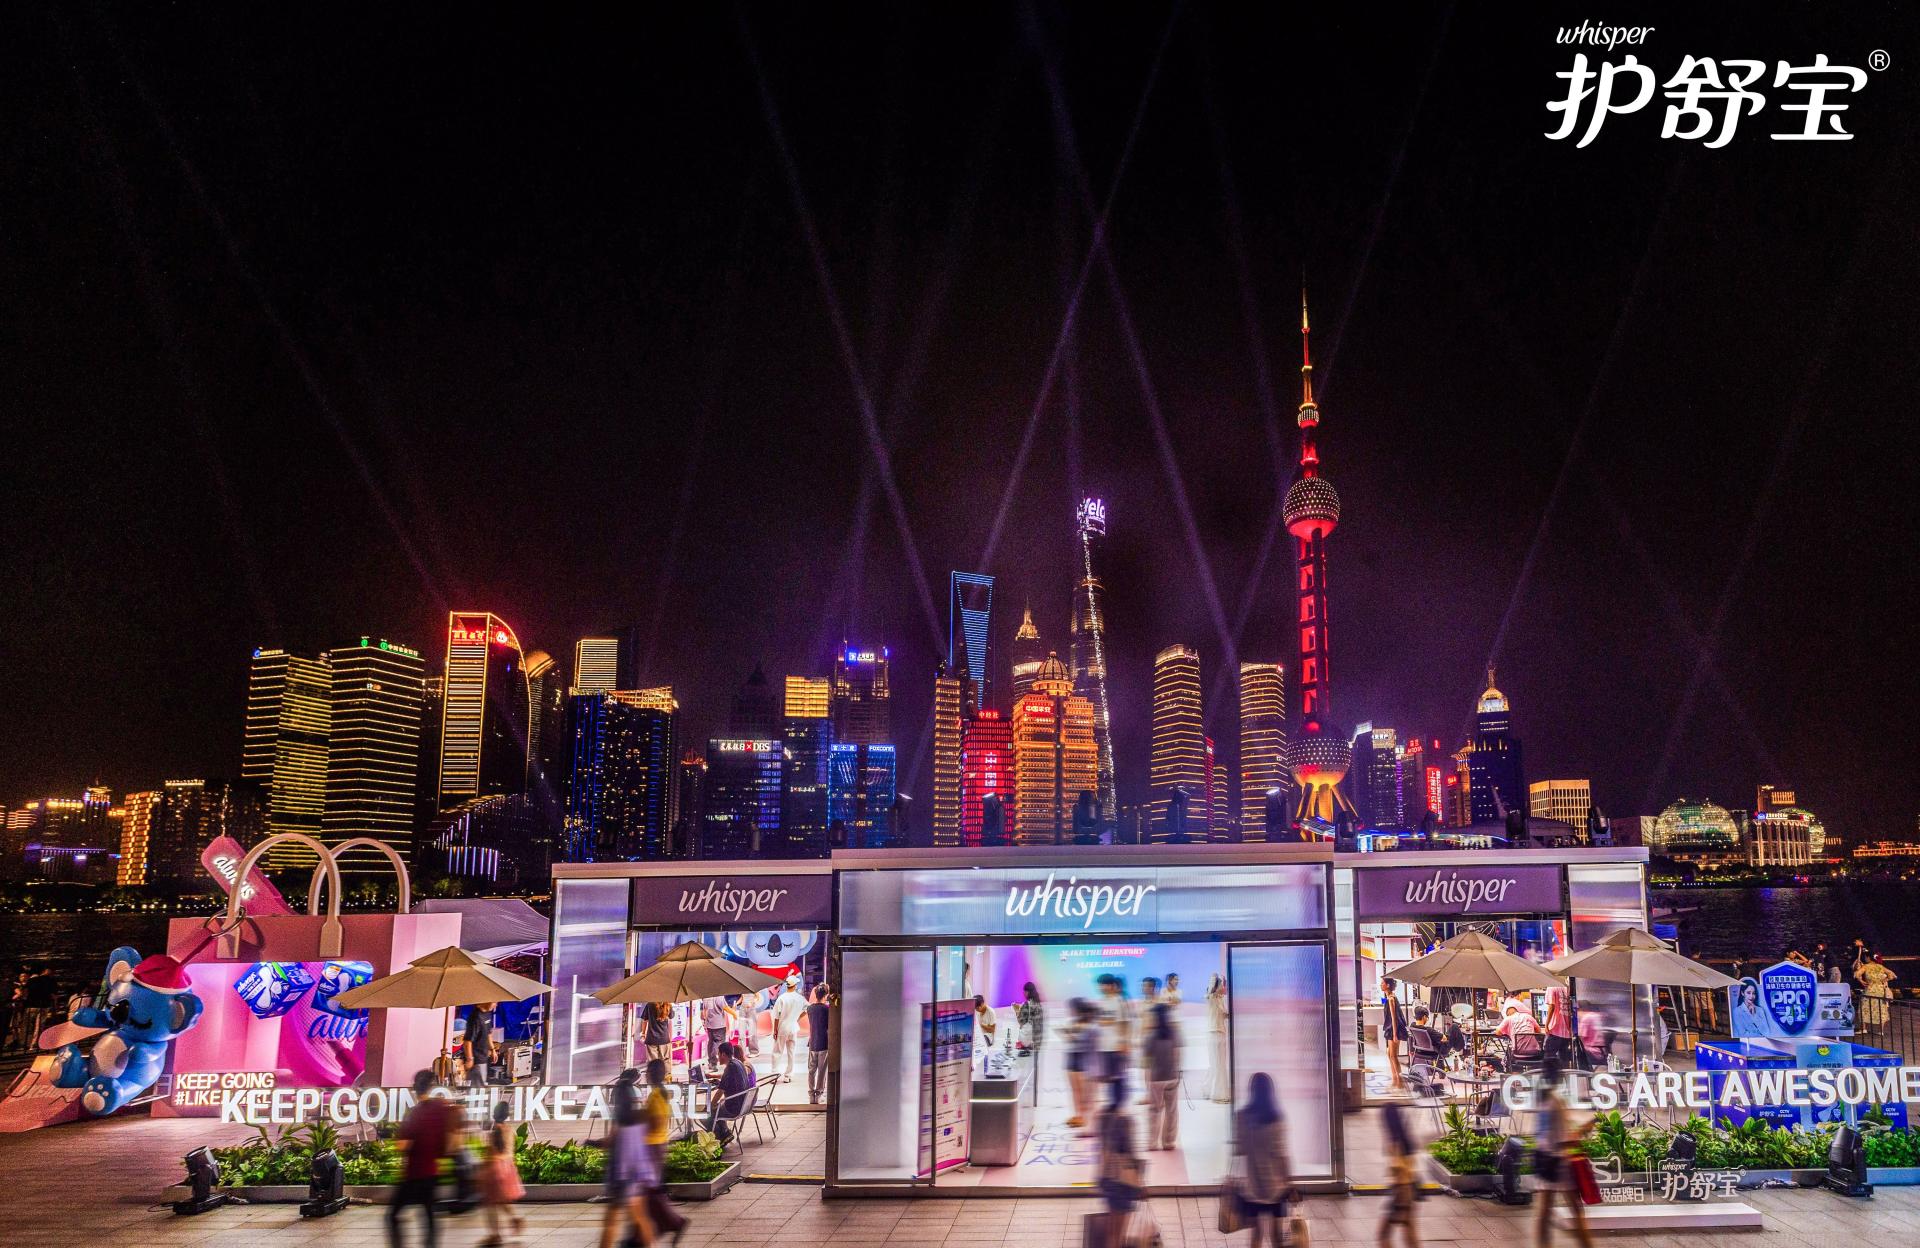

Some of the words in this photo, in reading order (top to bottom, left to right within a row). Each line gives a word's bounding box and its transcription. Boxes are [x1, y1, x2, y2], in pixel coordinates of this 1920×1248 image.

[752, 742, 771, 751] DBS
[678, 880, 788, 922] whisper
[1005, 872, 1157, 929] whisper
[1405, 870, 1517, 912] whisper
[1770, 990, 1811, 1008] PRO
[175, 1073, 219, 1089] KEEP
[221, 1072, 275, 1089] GOING
[1628, 1071, 1711, 1109] ARE
[1721, 1067, 1920, 1107] AWESOME
[220, 1088, 320, 1124] KEEP
[330, 1086, 453, 1123] GOIN
[1661, 1162, 1688, 1172] whisper
[1599, 1187, 1645, 1203] 级品牌日
[1661, 1171, 1741, 1201] 护舒宝
